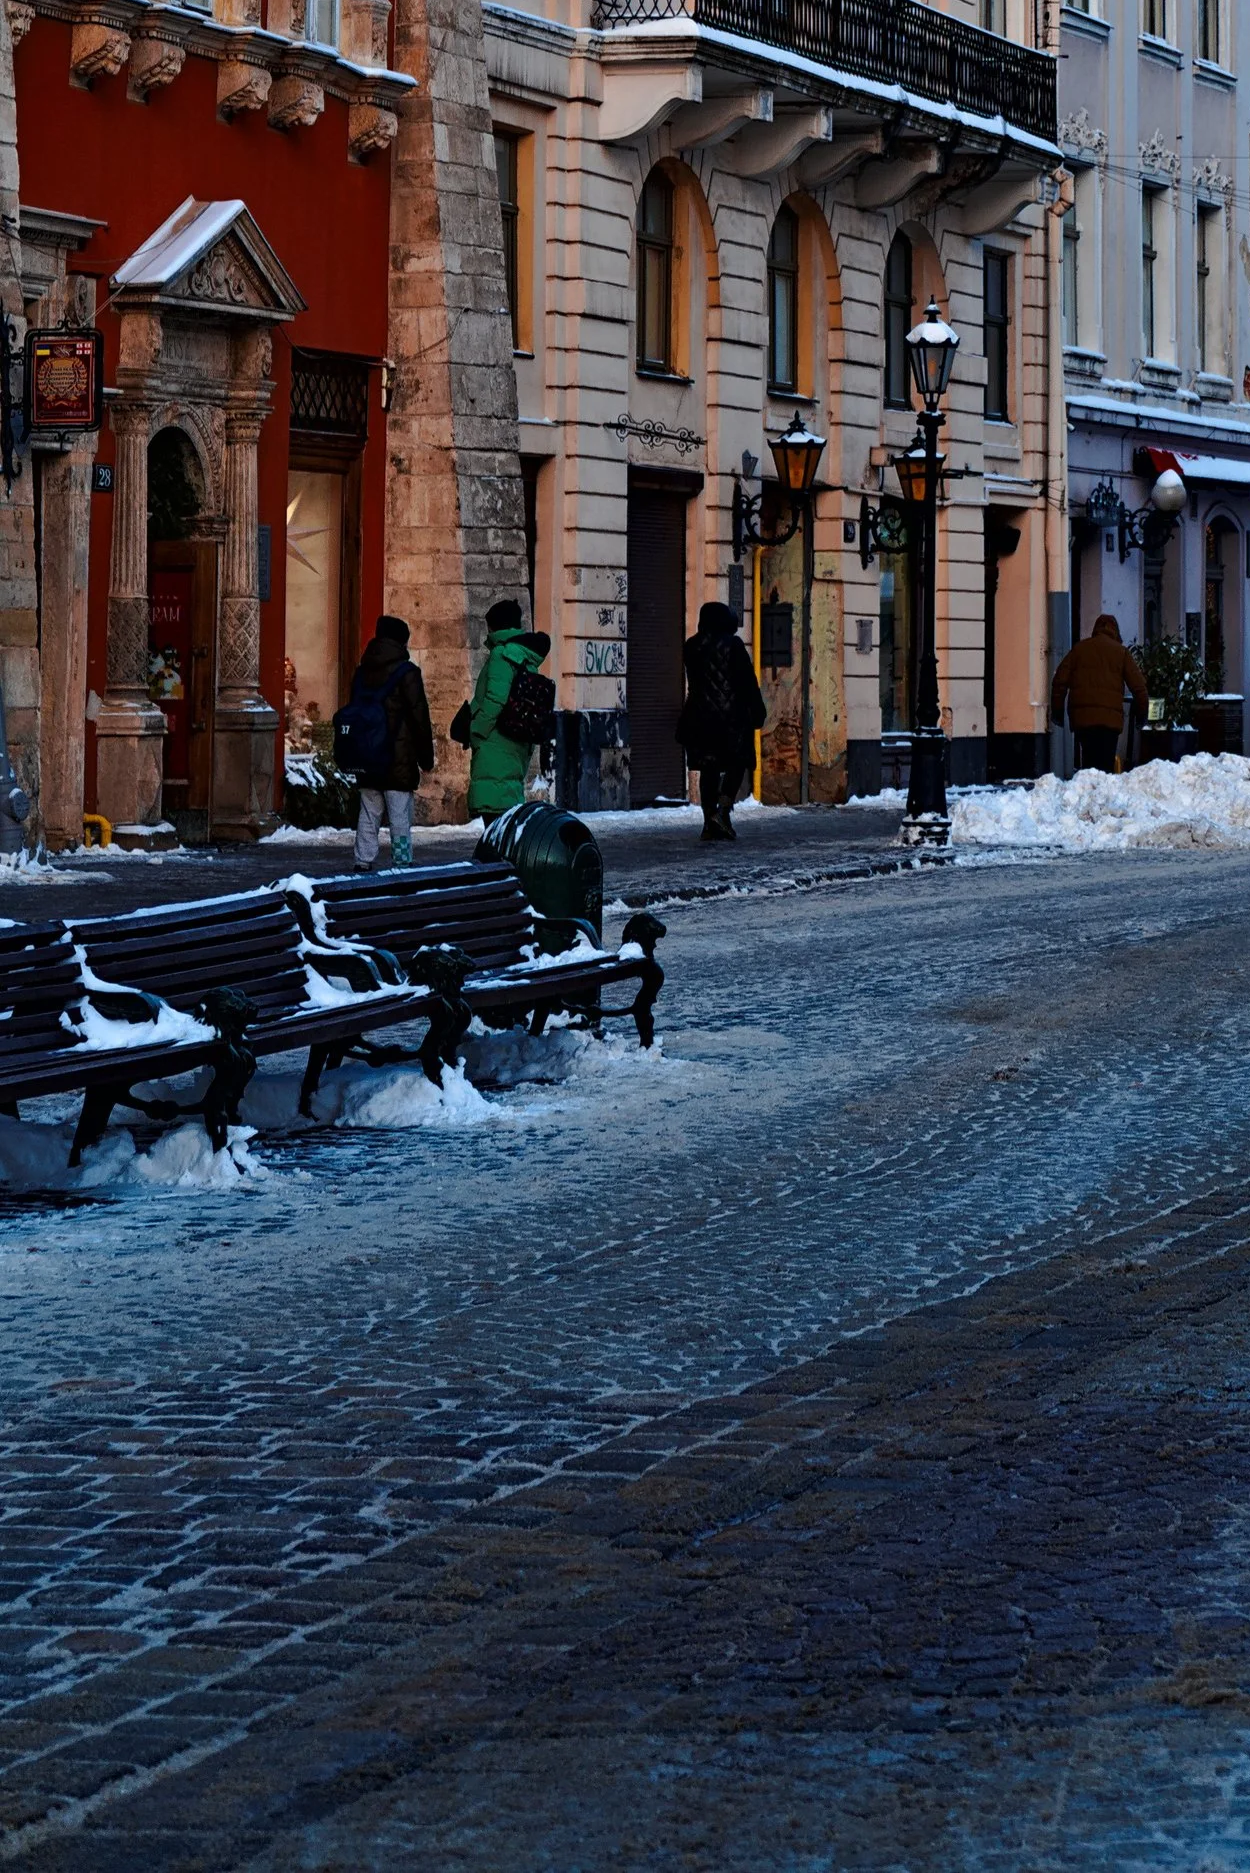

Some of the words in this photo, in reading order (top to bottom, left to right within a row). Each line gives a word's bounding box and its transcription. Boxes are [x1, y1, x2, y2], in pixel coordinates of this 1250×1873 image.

[99, 468, 111, 487] 28
[147, 606, 180, 625] RAM
[341, 724, 350, 735] 37
